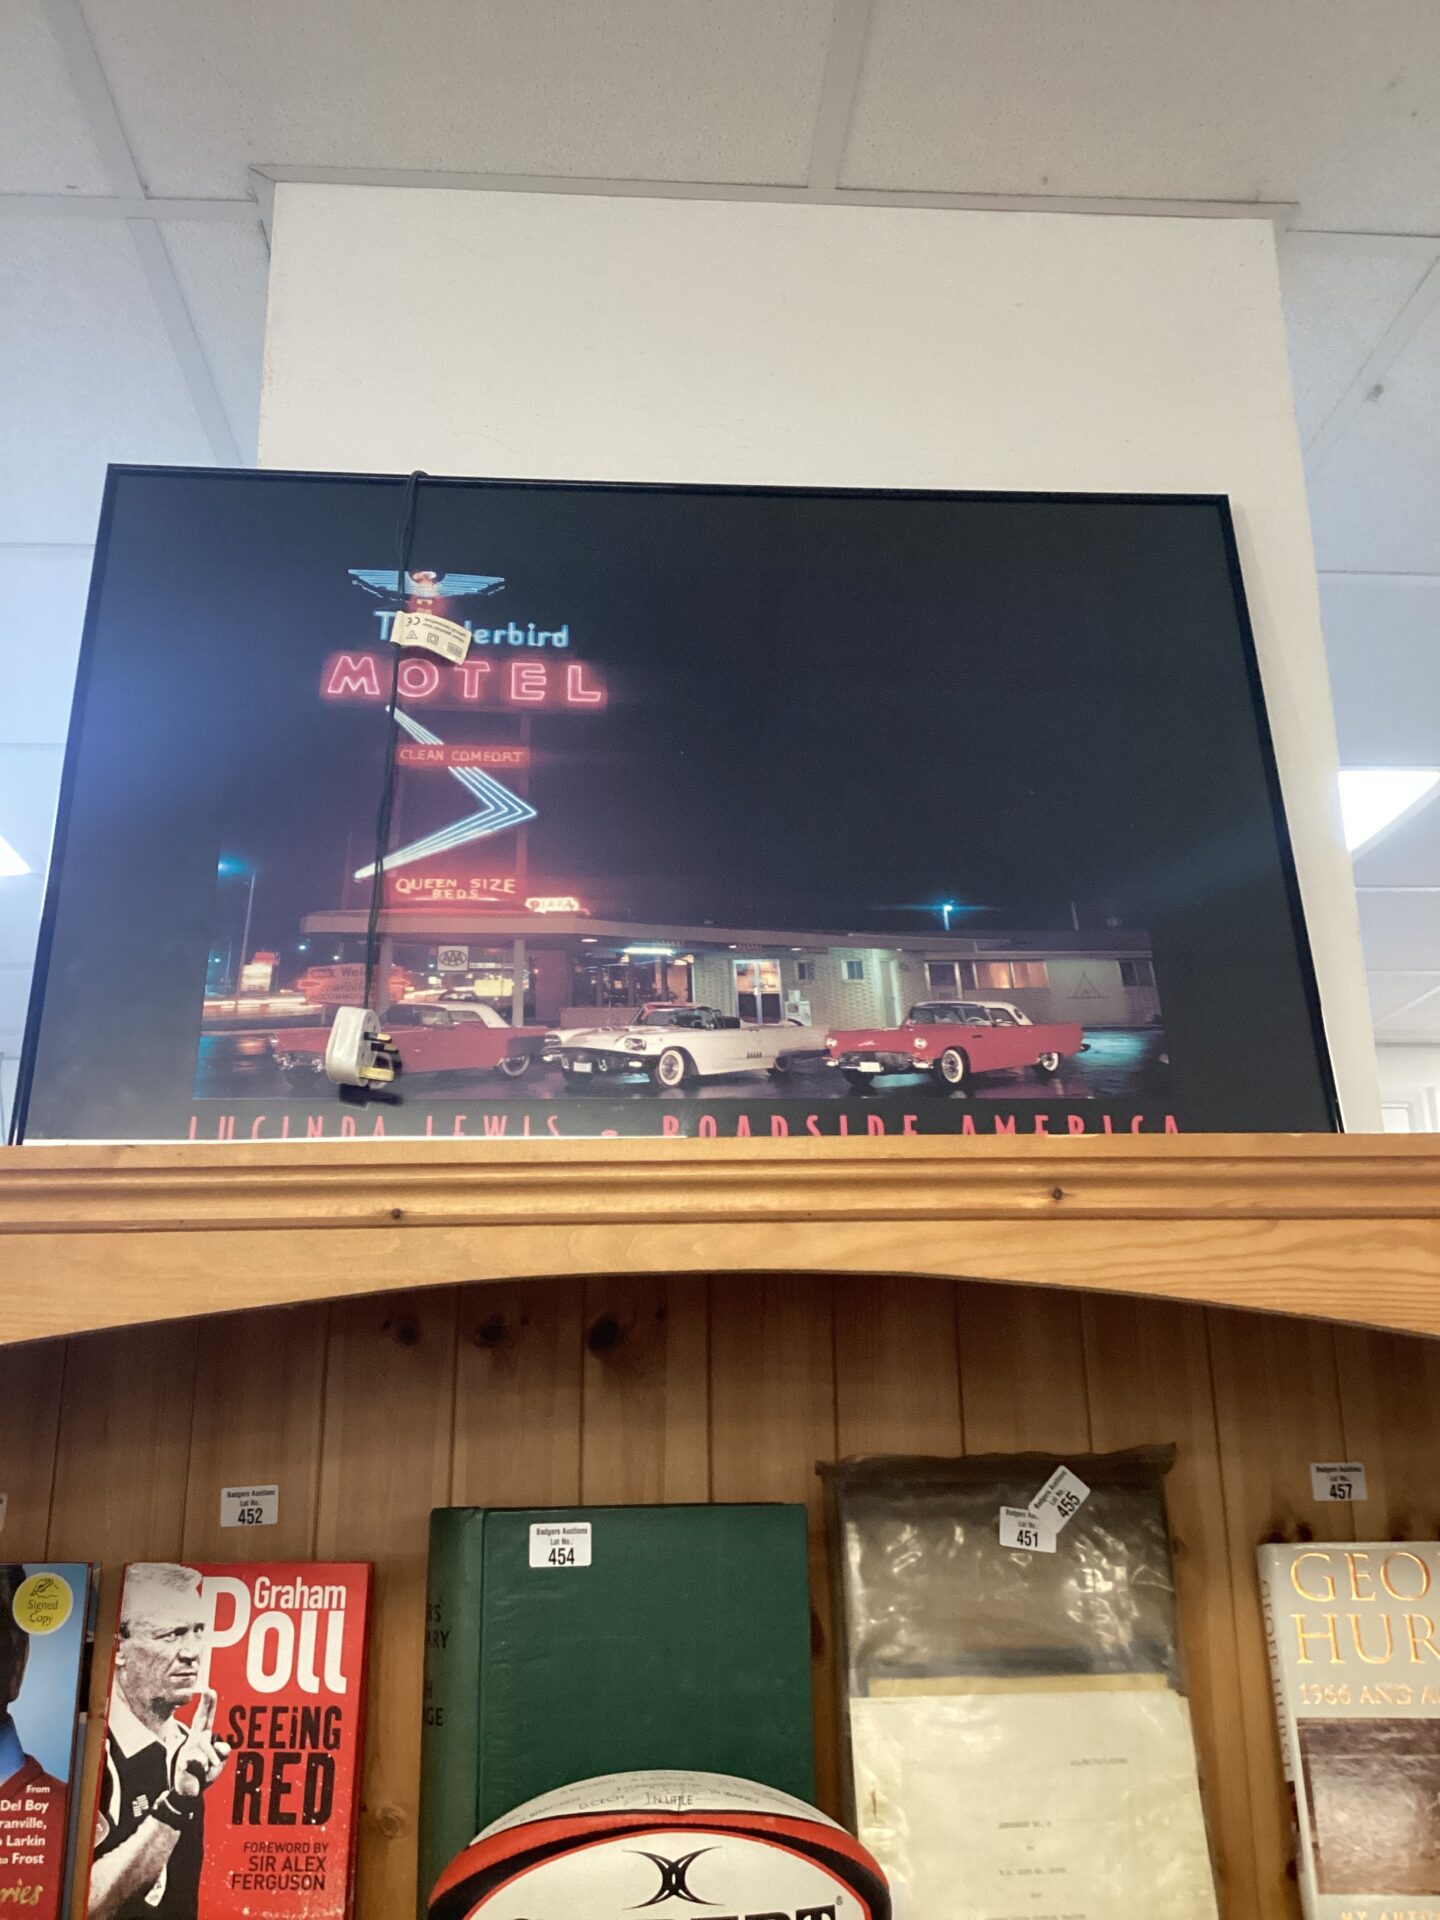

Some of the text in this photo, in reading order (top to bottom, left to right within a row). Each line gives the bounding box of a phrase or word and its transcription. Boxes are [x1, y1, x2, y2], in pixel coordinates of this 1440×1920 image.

[373, 610, 570, 648] Terbird
[327, 655, 601, 702] MOTEL
[400, 749, 524, 762] CLEAN COMFORT
[395, 878, 516, 894] QUEEN SIZE
[432, 889, 479, 900] BEDS
[1329, 1484, 1352, 1500] 457
[1057, 1491, 1081, 1518] 455
[238, 1507, 263, 1525] 452
[536, 1528, 560, 1536] Badgers
[1016, 1529, 1038, 1548] 451
[548, 1547, 575, 1565] 454
[1290, 1552, 1440, 1603] GEO
[254, 1576, 347, 1610] Graham
[27, 1599, 59, 1613] Signed
[29, 1612, 54, 1627] Copy
[193, 1576, 348, 1694] Poll
[1359, 1684, 1414, 1705] AND
[26, 1784, 51, 1794] From
[231, 1751, 336, 1826] RED
[0, 1799, 49, 1815] Del Boy
[6, 1834, 46, 1847] Larkin
[243, 1841, 330, 1854] FOREWORD BY
[12, 1852, 45, 1865] Frost
[248, 1856, 327, 1872] SIR ALEX
[231, 1873, 326, 1891] FERGUSON
